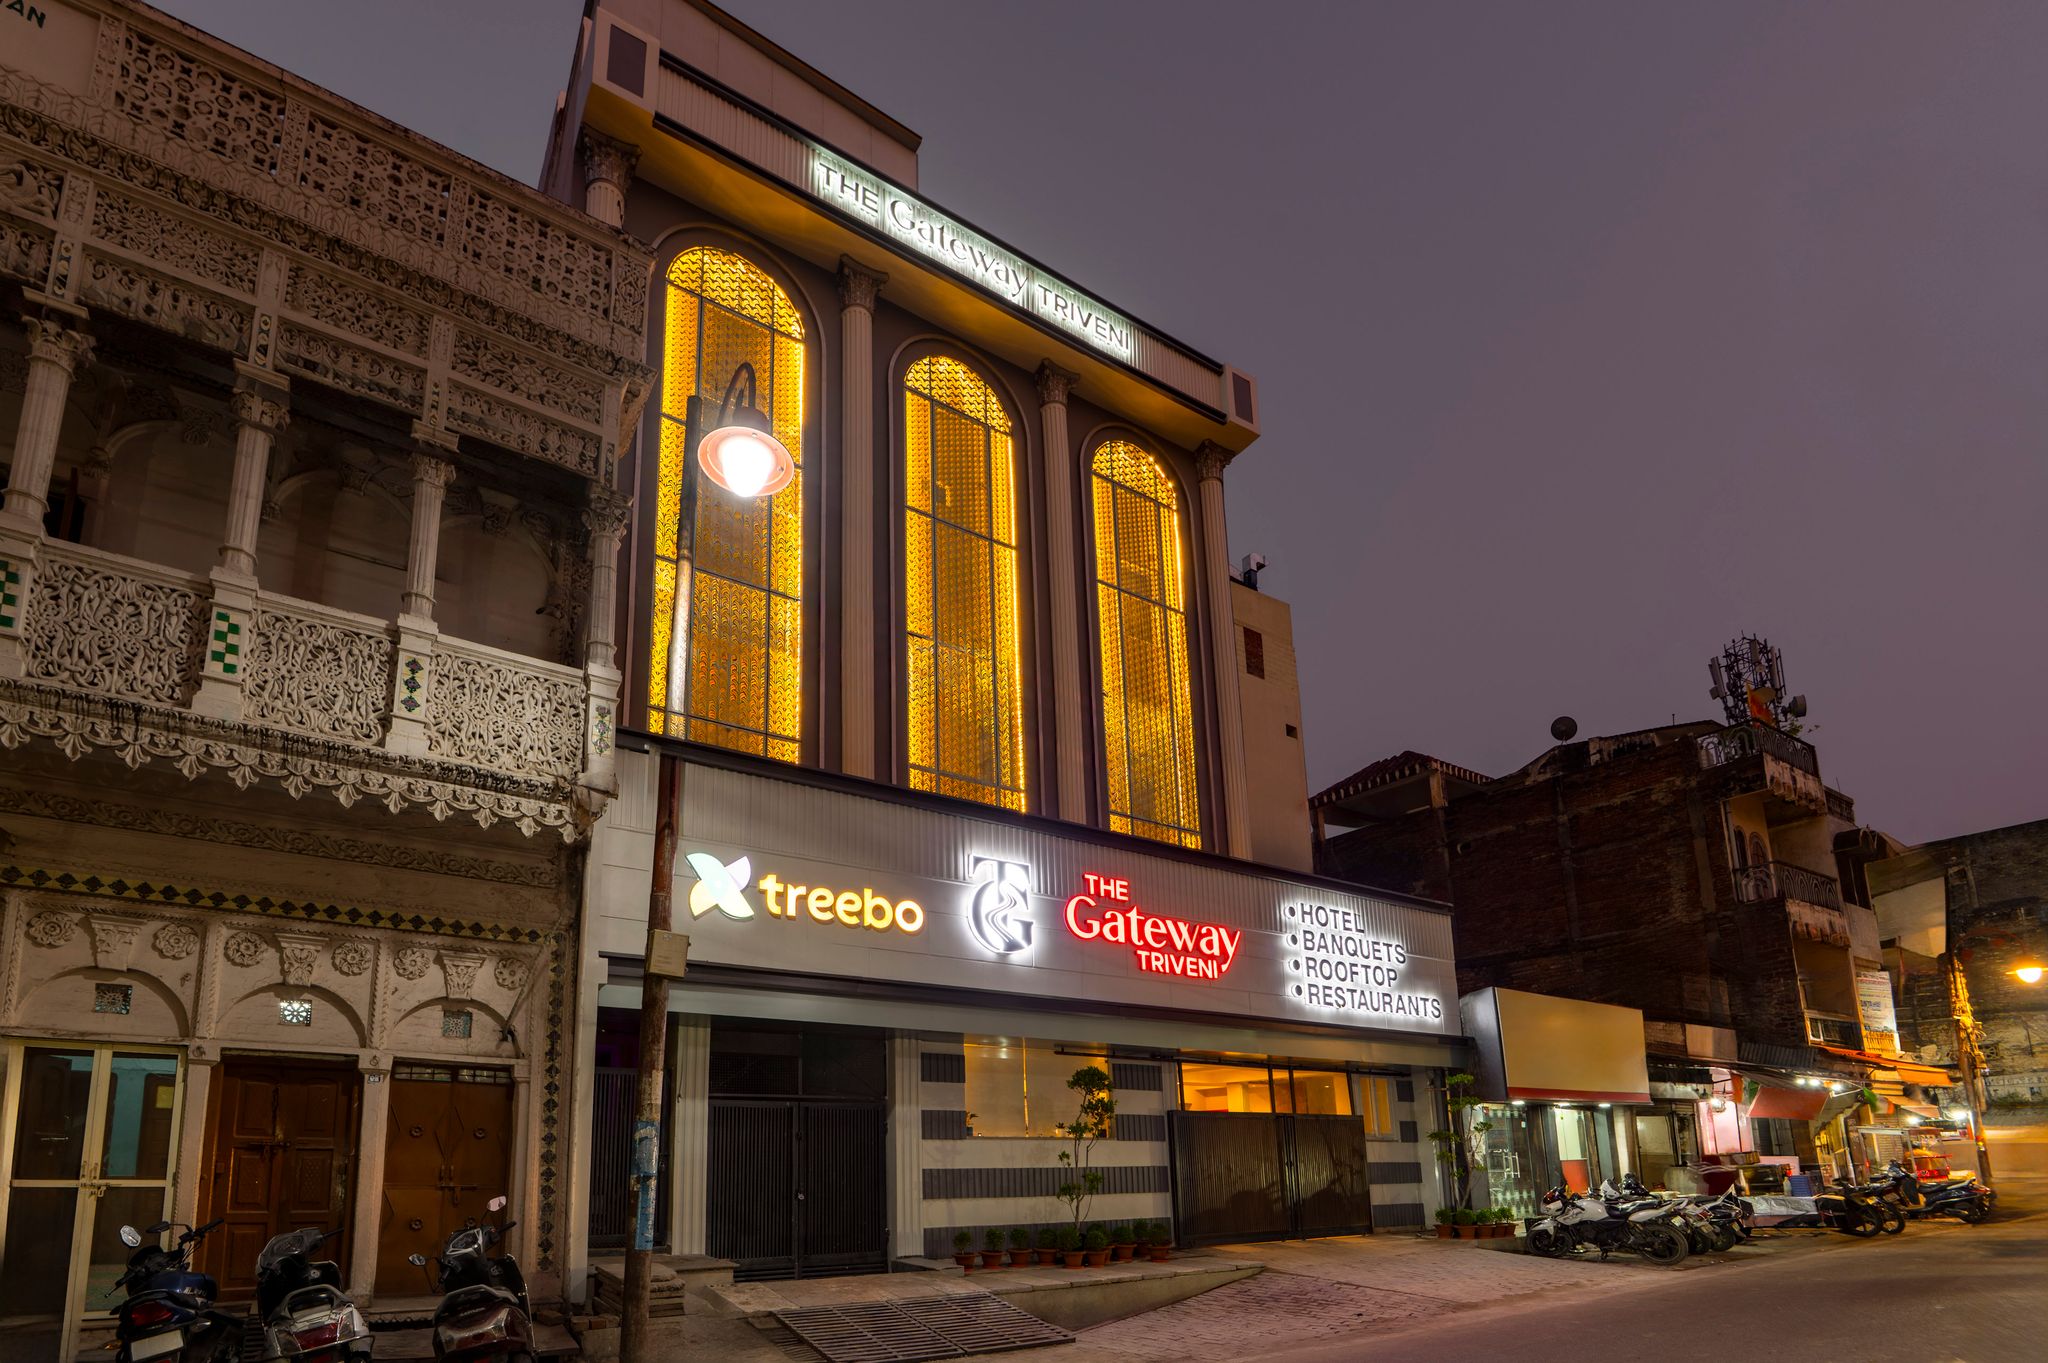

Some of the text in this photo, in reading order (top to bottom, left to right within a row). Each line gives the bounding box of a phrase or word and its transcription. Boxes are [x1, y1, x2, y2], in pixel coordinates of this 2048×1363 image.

[818, 162, 1130, 352] THE Gateway TRIVENI
[758, 873, 925, 935] treebo
[1083, 873, 1130, 902] THE
[1065, 894, 1241, 972] Gateway
[1299, 902, 1365, 934] HOTEL
[1136, 949, 1220, 980] TRIVENI
[1302, 930, 1407, 965] BANQUETS
[1305, 956, 1398, 988] ROOFTOP
[1308, 982, 1442, 1020] RESTAURANTS
